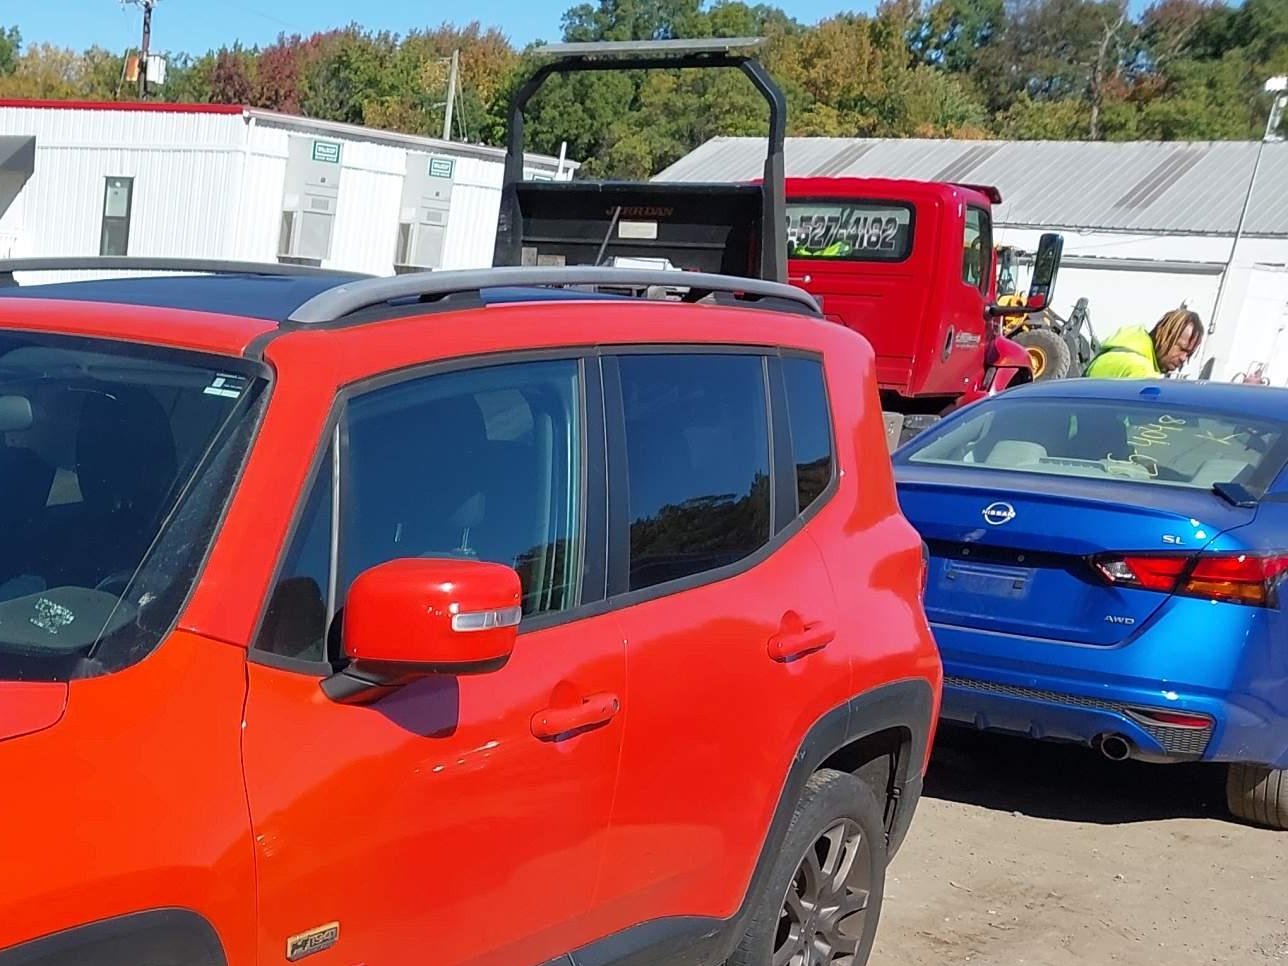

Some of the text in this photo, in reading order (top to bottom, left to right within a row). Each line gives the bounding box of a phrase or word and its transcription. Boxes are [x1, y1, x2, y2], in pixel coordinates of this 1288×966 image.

[982, 509, 1016, 518] NISSAN
[1161, 534, 1187, 545] SL
[1104, 614, 1135, 625] AWD
